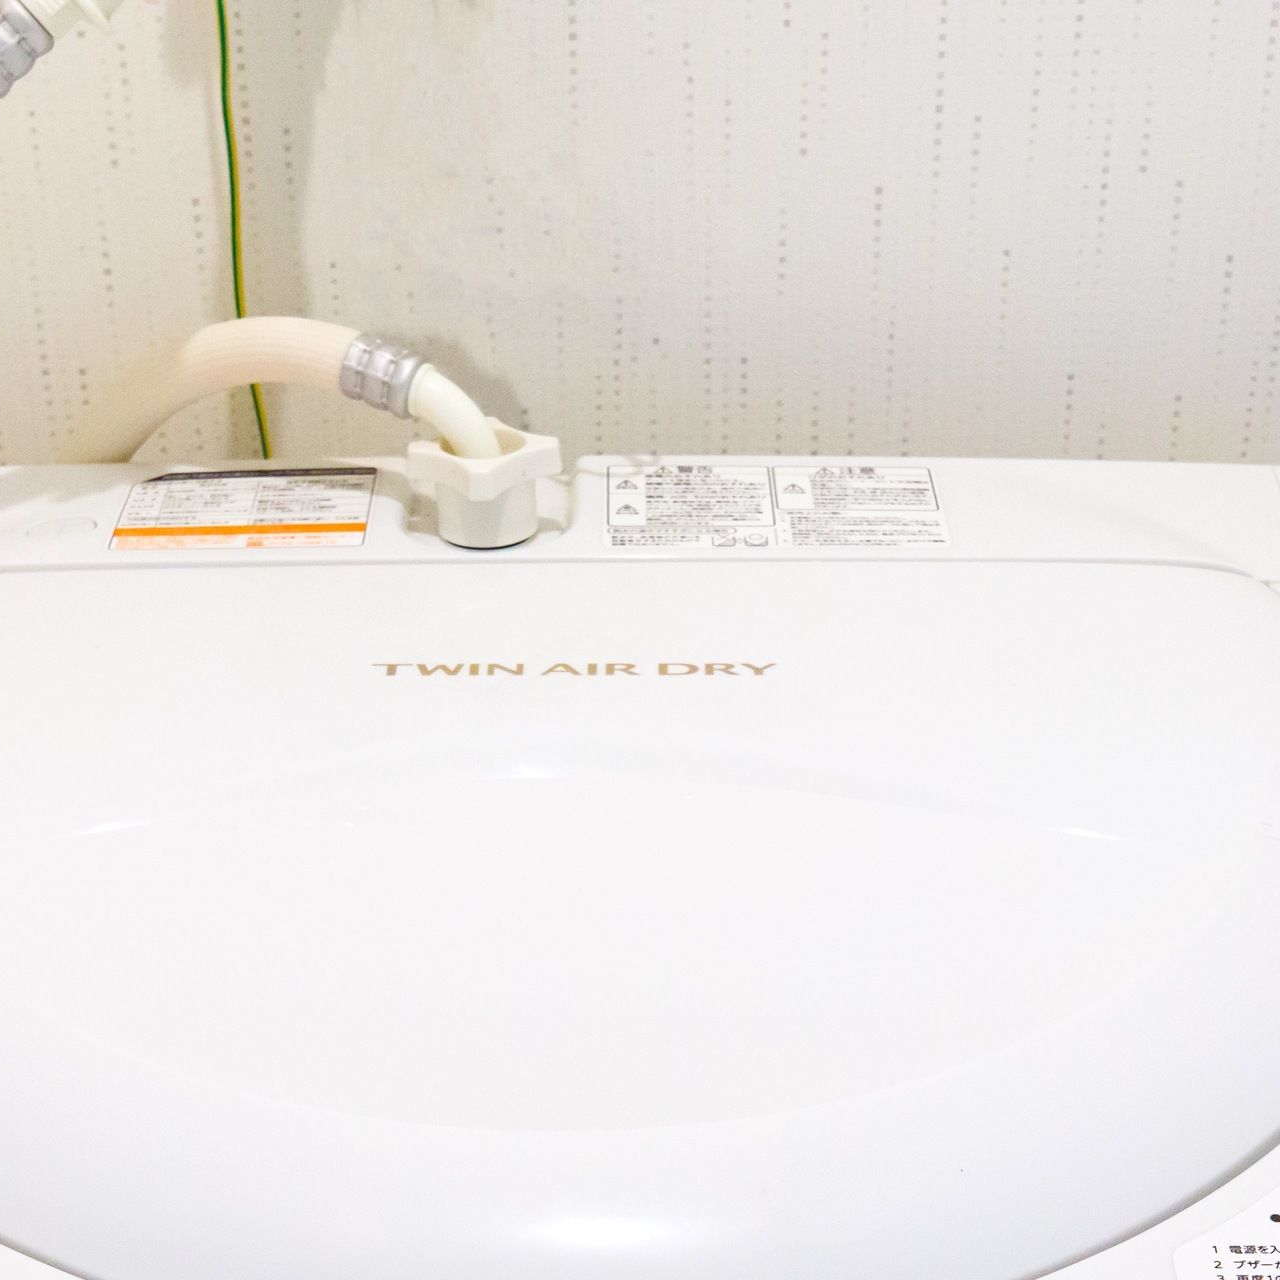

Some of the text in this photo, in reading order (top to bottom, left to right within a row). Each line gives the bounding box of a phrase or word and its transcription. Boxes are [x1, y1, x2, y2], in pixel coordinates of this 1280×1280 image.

[372, 662, 778, 677] TWIN AIR DRY
[1212, 1245, 1219, 1254] 1
[1214, 1260, 1223, 1269] 2
